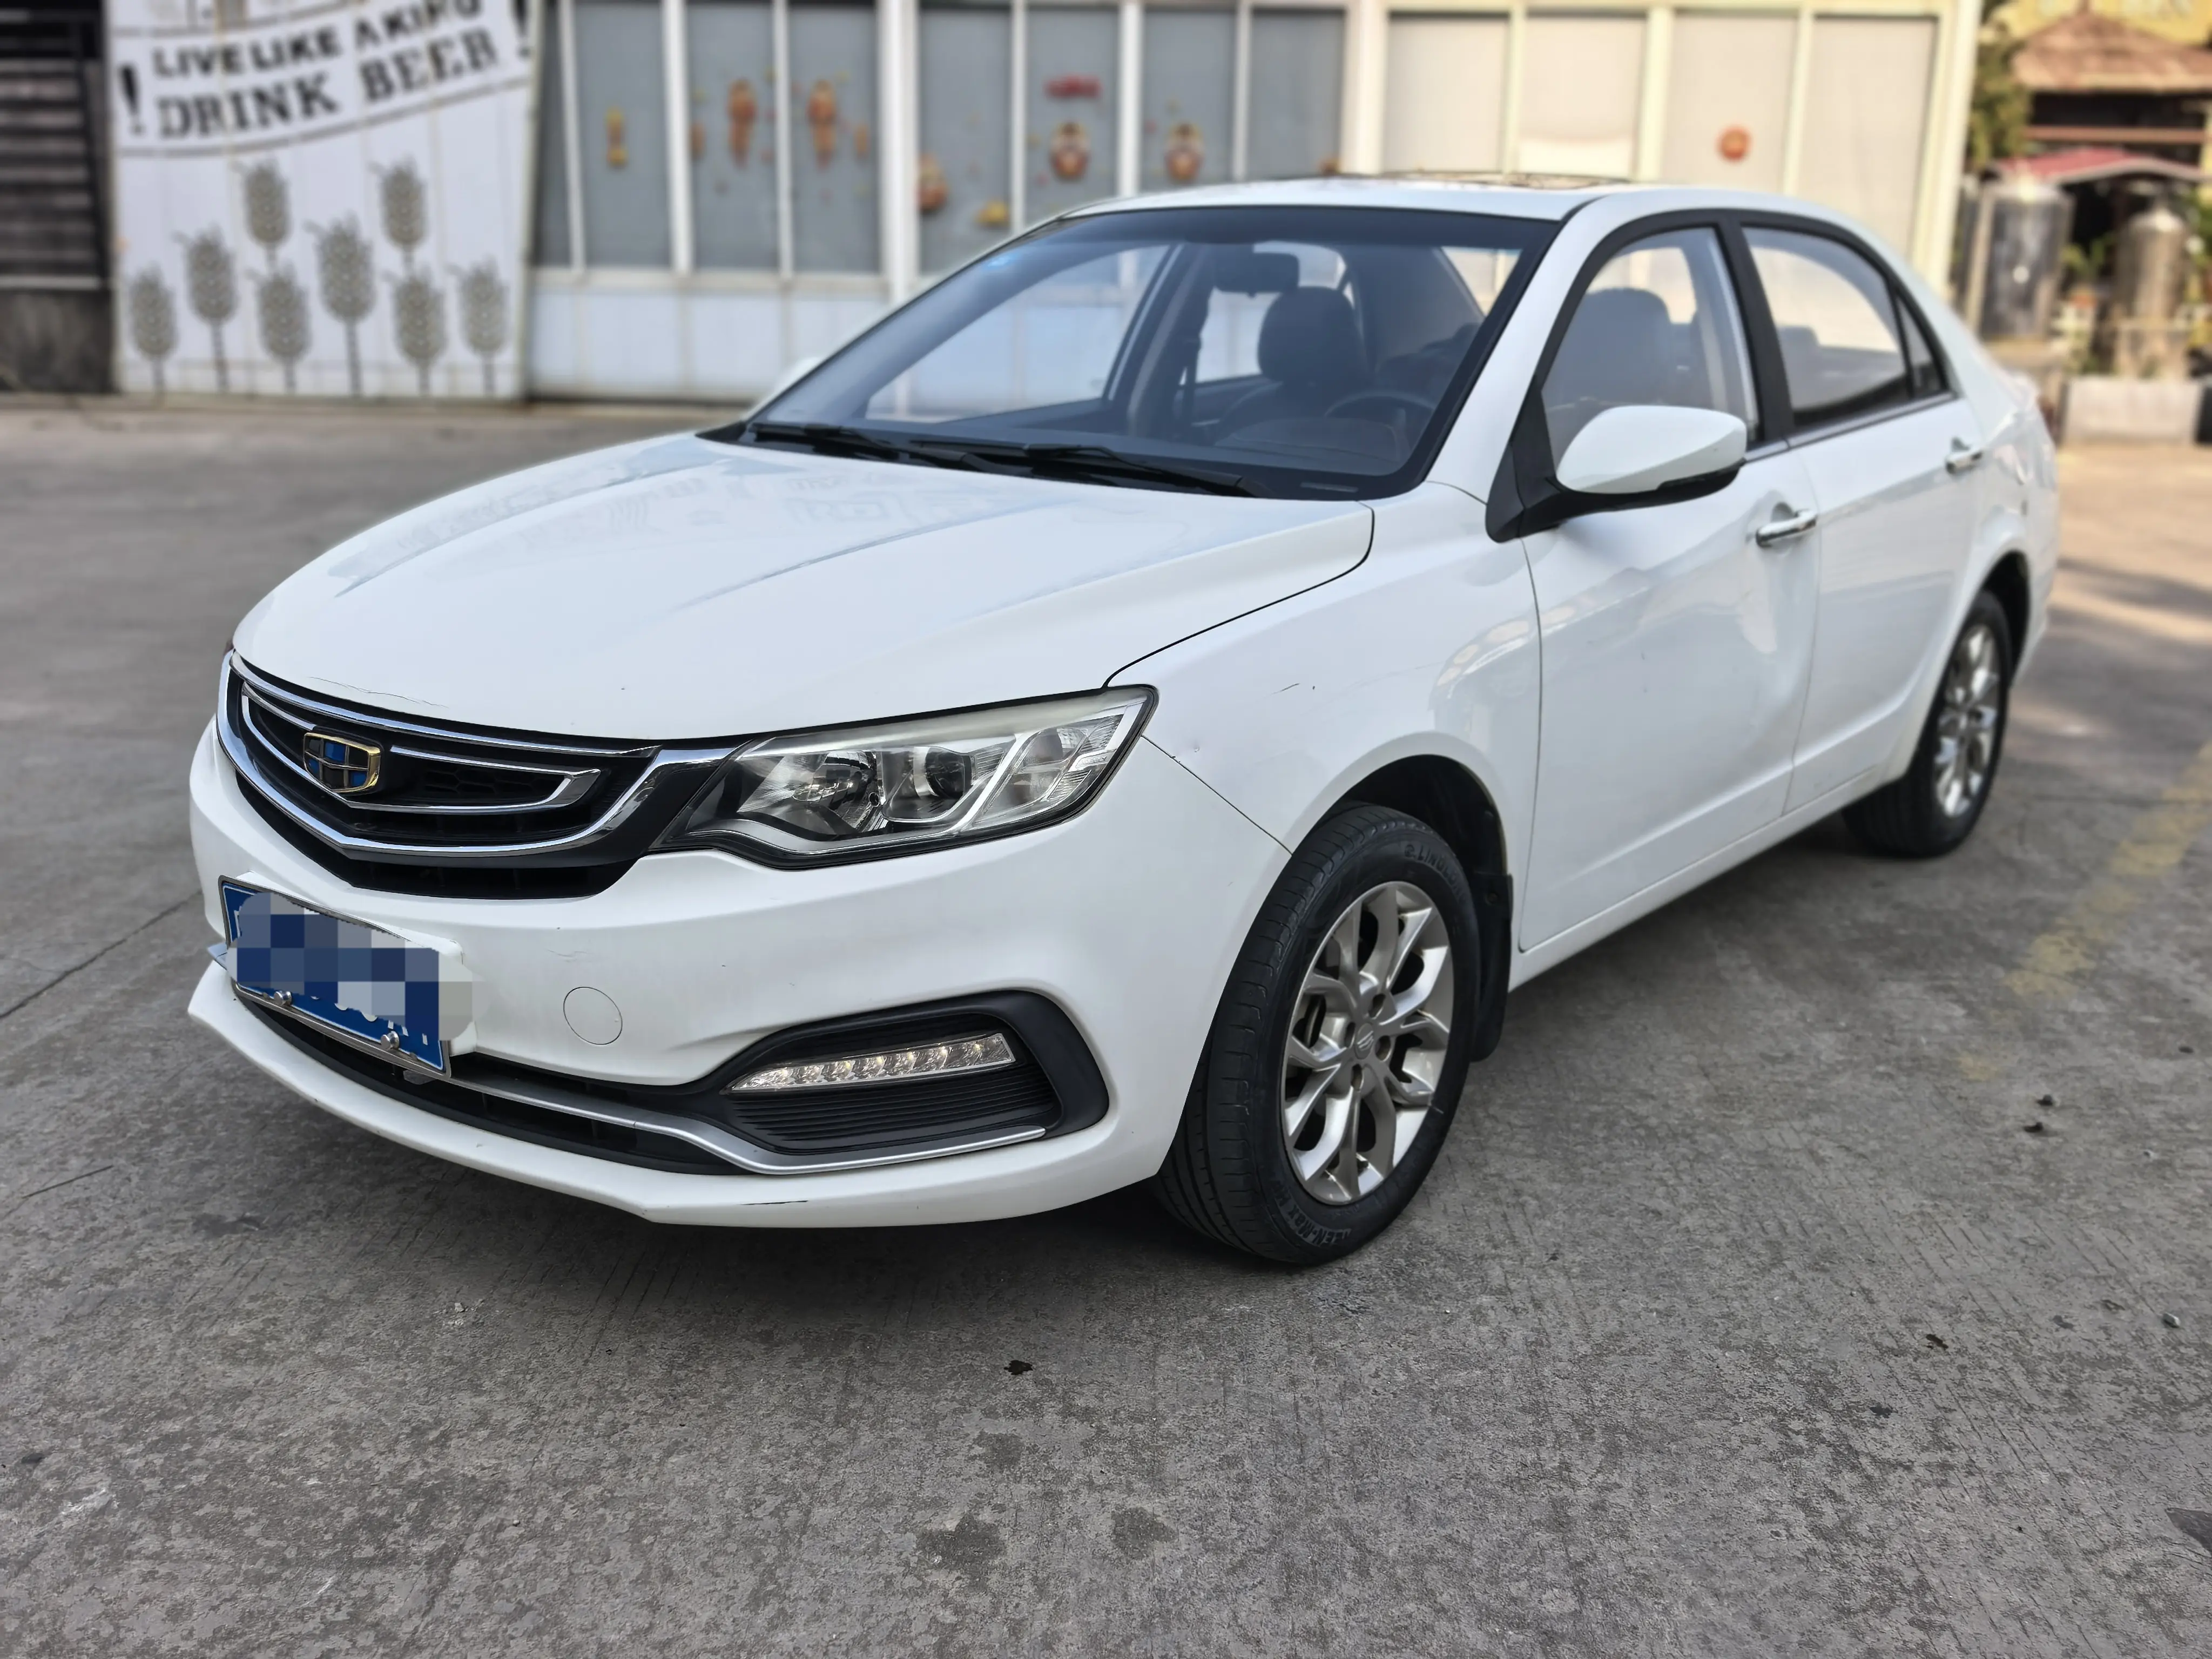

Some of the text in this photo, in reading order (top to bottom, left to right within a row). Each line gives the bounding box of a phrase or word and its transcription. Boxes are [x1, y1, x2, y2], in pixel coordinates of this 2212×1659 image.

[153, 46, 244, 80] LIVE
[248, 27, 342, 72] LIKE
[354, 16, 382, 51] A
[156, 27, 500, 138] DRINK BEER
